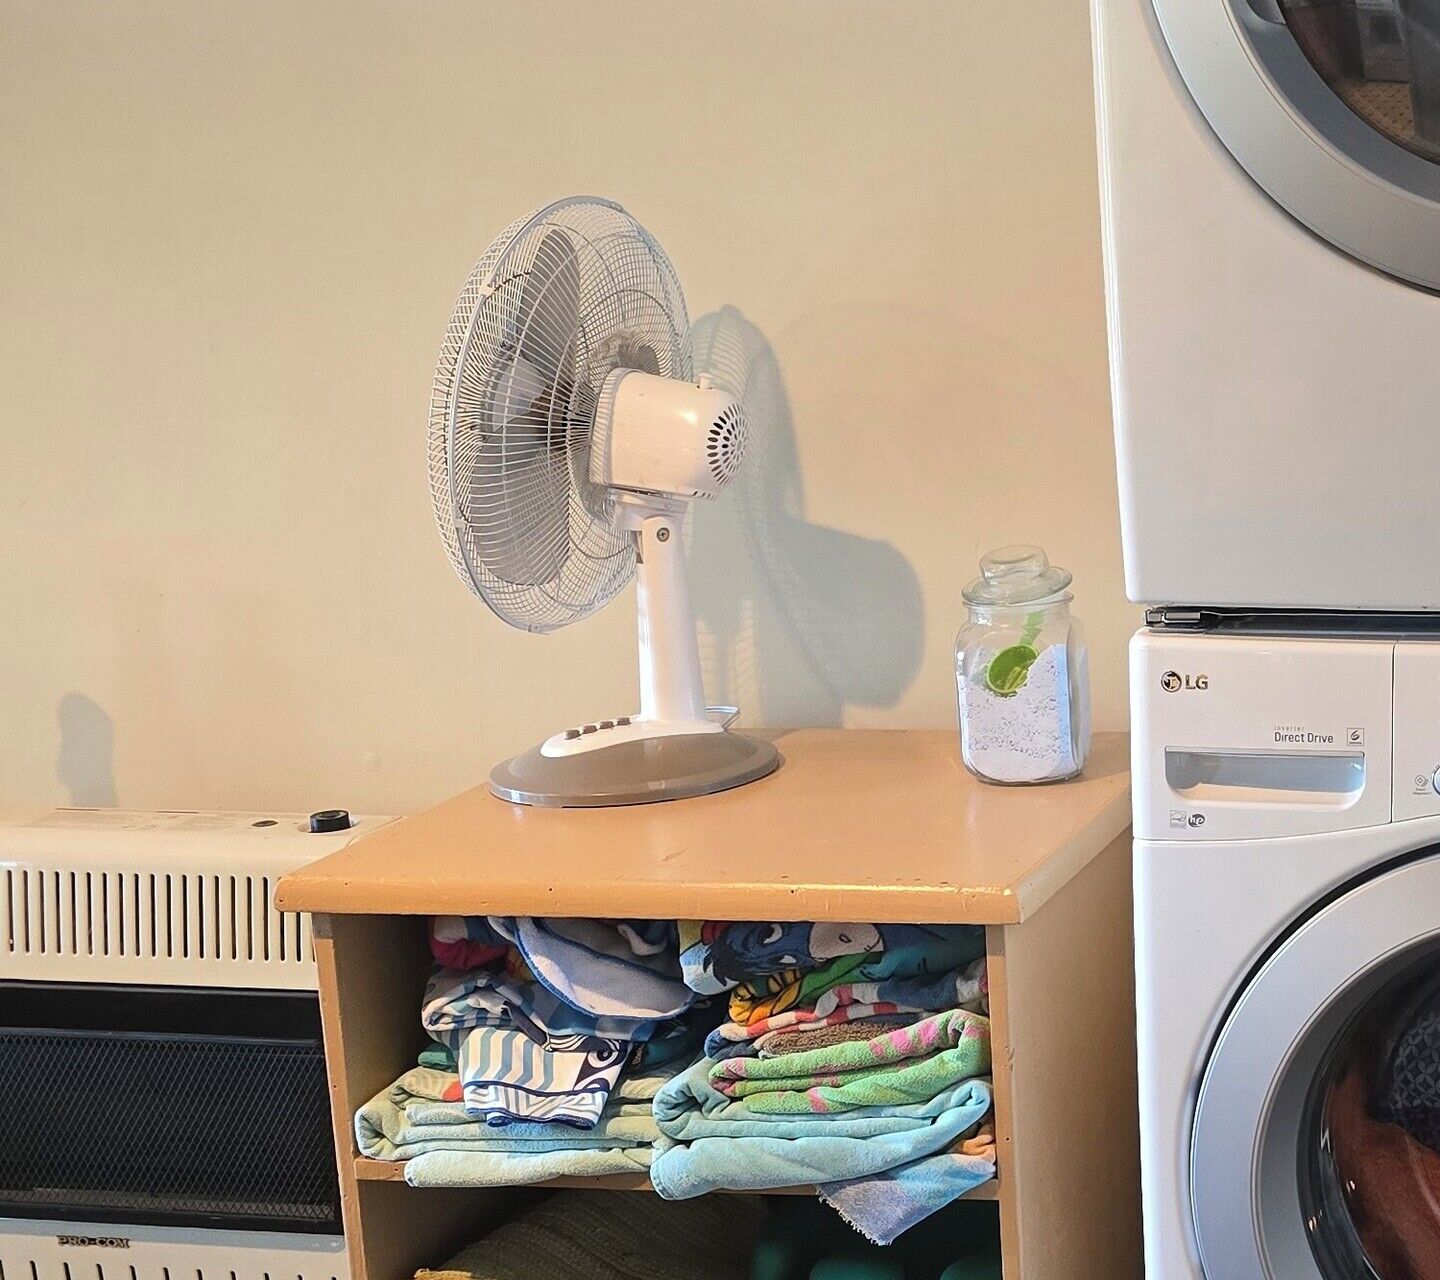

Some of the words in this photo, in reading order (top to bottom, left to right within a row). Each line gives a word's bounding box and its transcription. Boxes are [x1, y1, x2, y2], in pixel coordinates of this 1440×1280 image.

[1185, 674, 1208, 690] LG
[1274, 732, 1305, 742] Direct
[1308, 732, 1334, 743] Drive
[56, 1234, 130, 1249] PRO-COM
